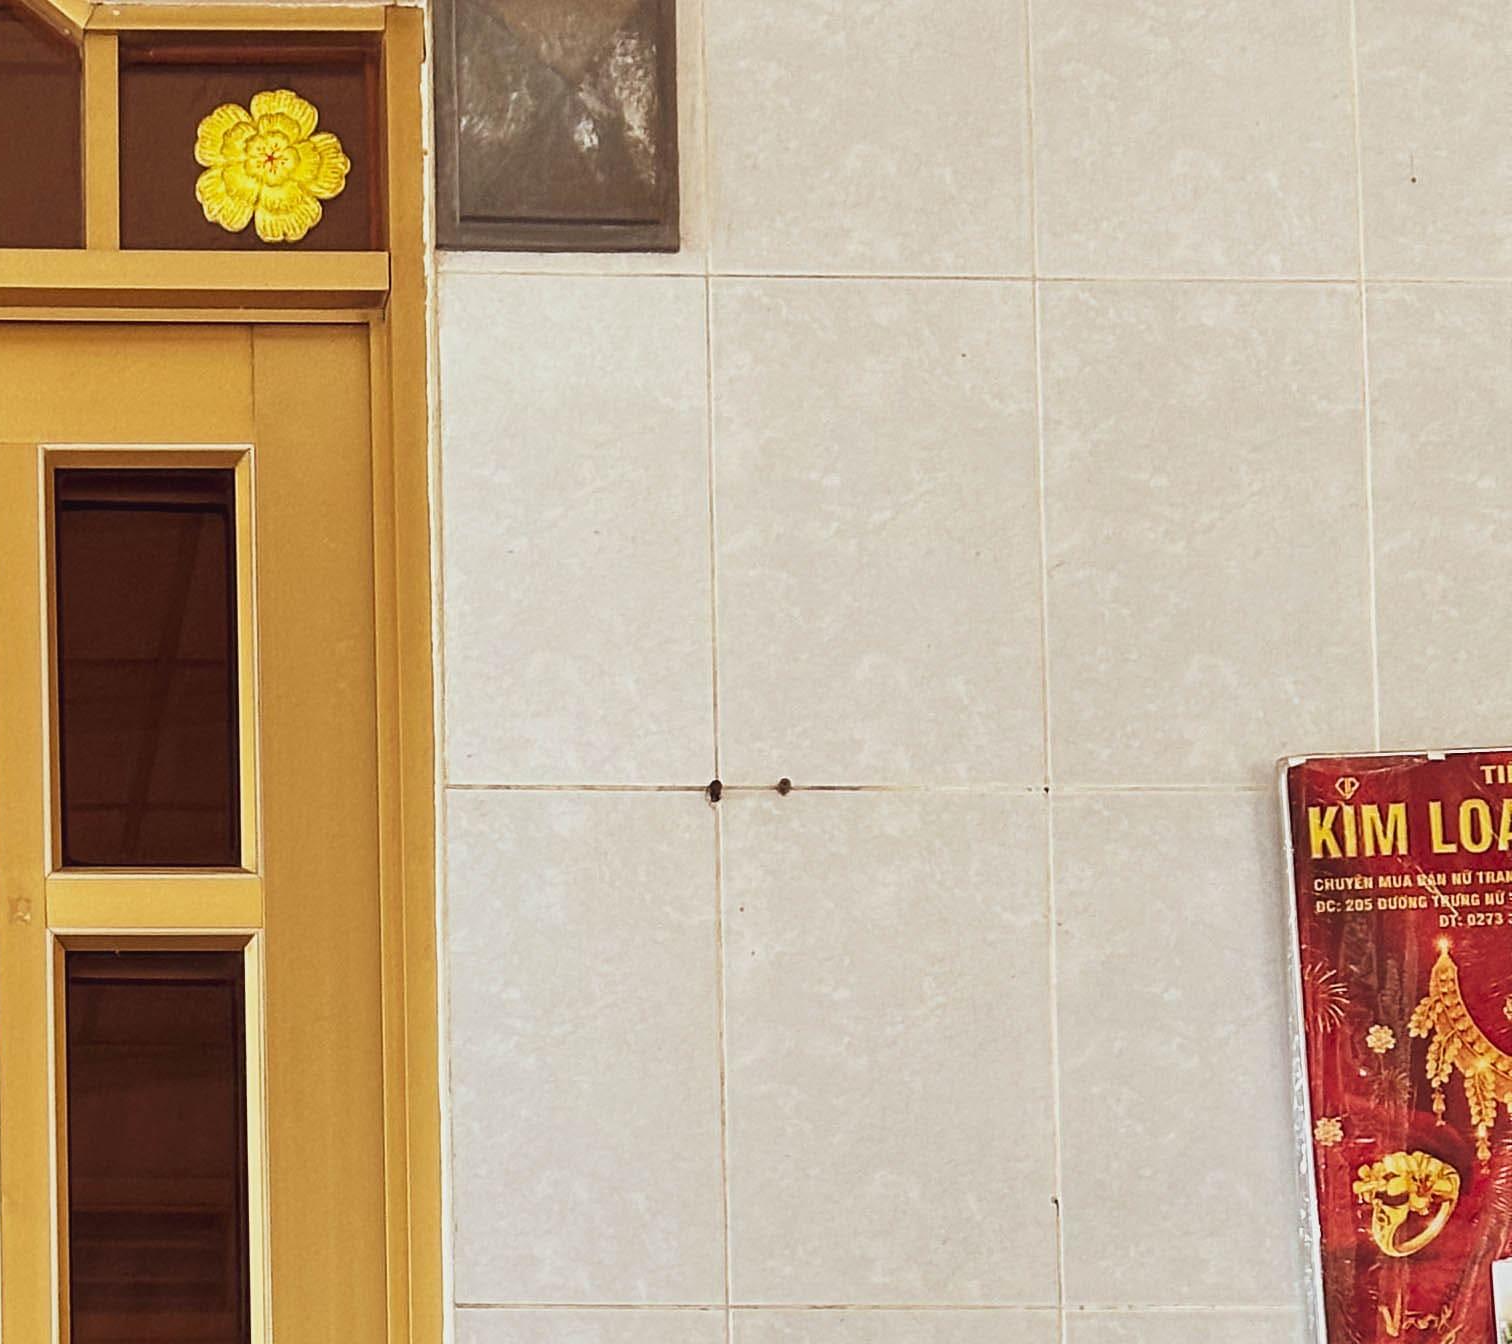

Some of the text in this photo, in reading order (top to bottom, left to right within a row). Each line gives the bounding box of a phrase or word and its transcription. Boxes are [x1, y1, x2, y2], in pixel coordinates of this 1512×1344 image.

[1308, 803, 1408, 859] KIM
[1379, 874, 1412, 888] MUA
[1345, 898, 1373, 912] 205
[1467, 912, 1504, 926] 0273
